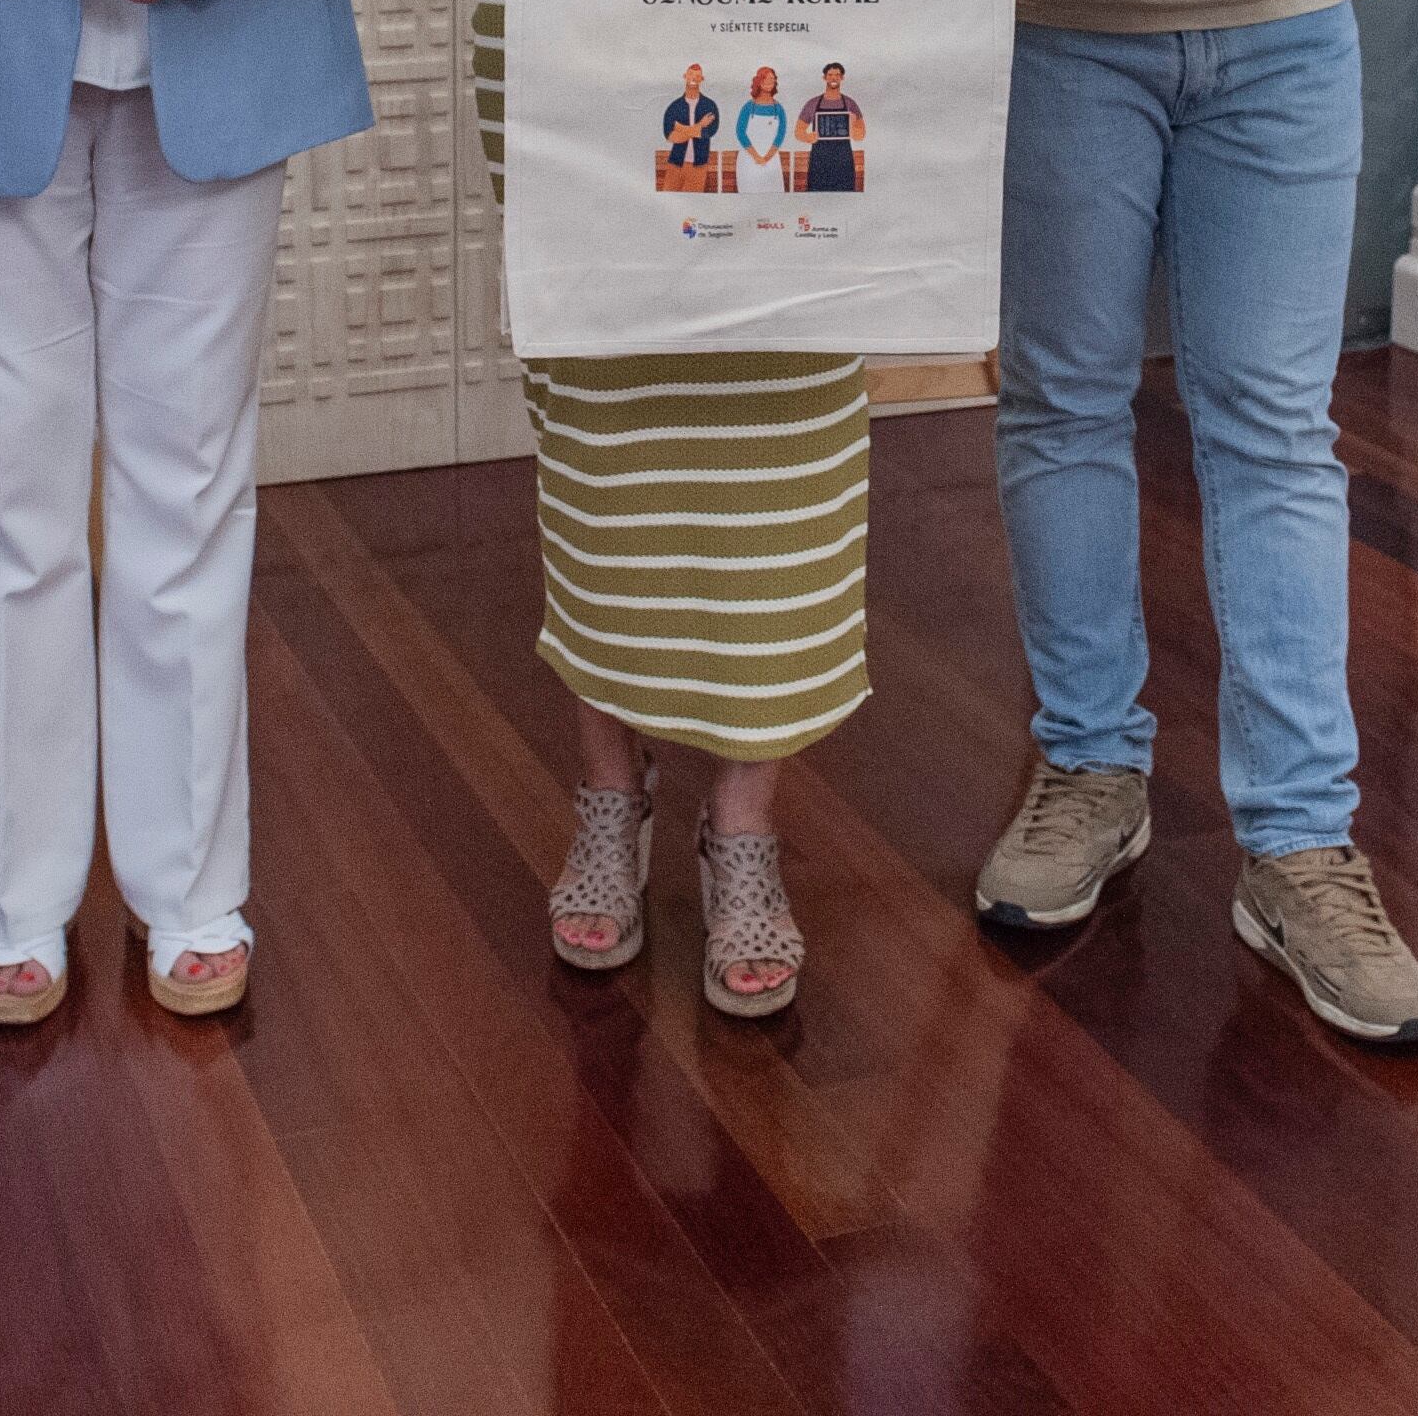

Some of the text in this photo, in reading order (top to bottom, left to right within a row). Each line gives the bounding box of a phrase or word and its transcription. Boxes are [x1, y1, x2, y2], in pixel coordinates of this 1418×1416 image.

[710, 19, 810, 33] Y SIÉNTETE ESPECIAL
